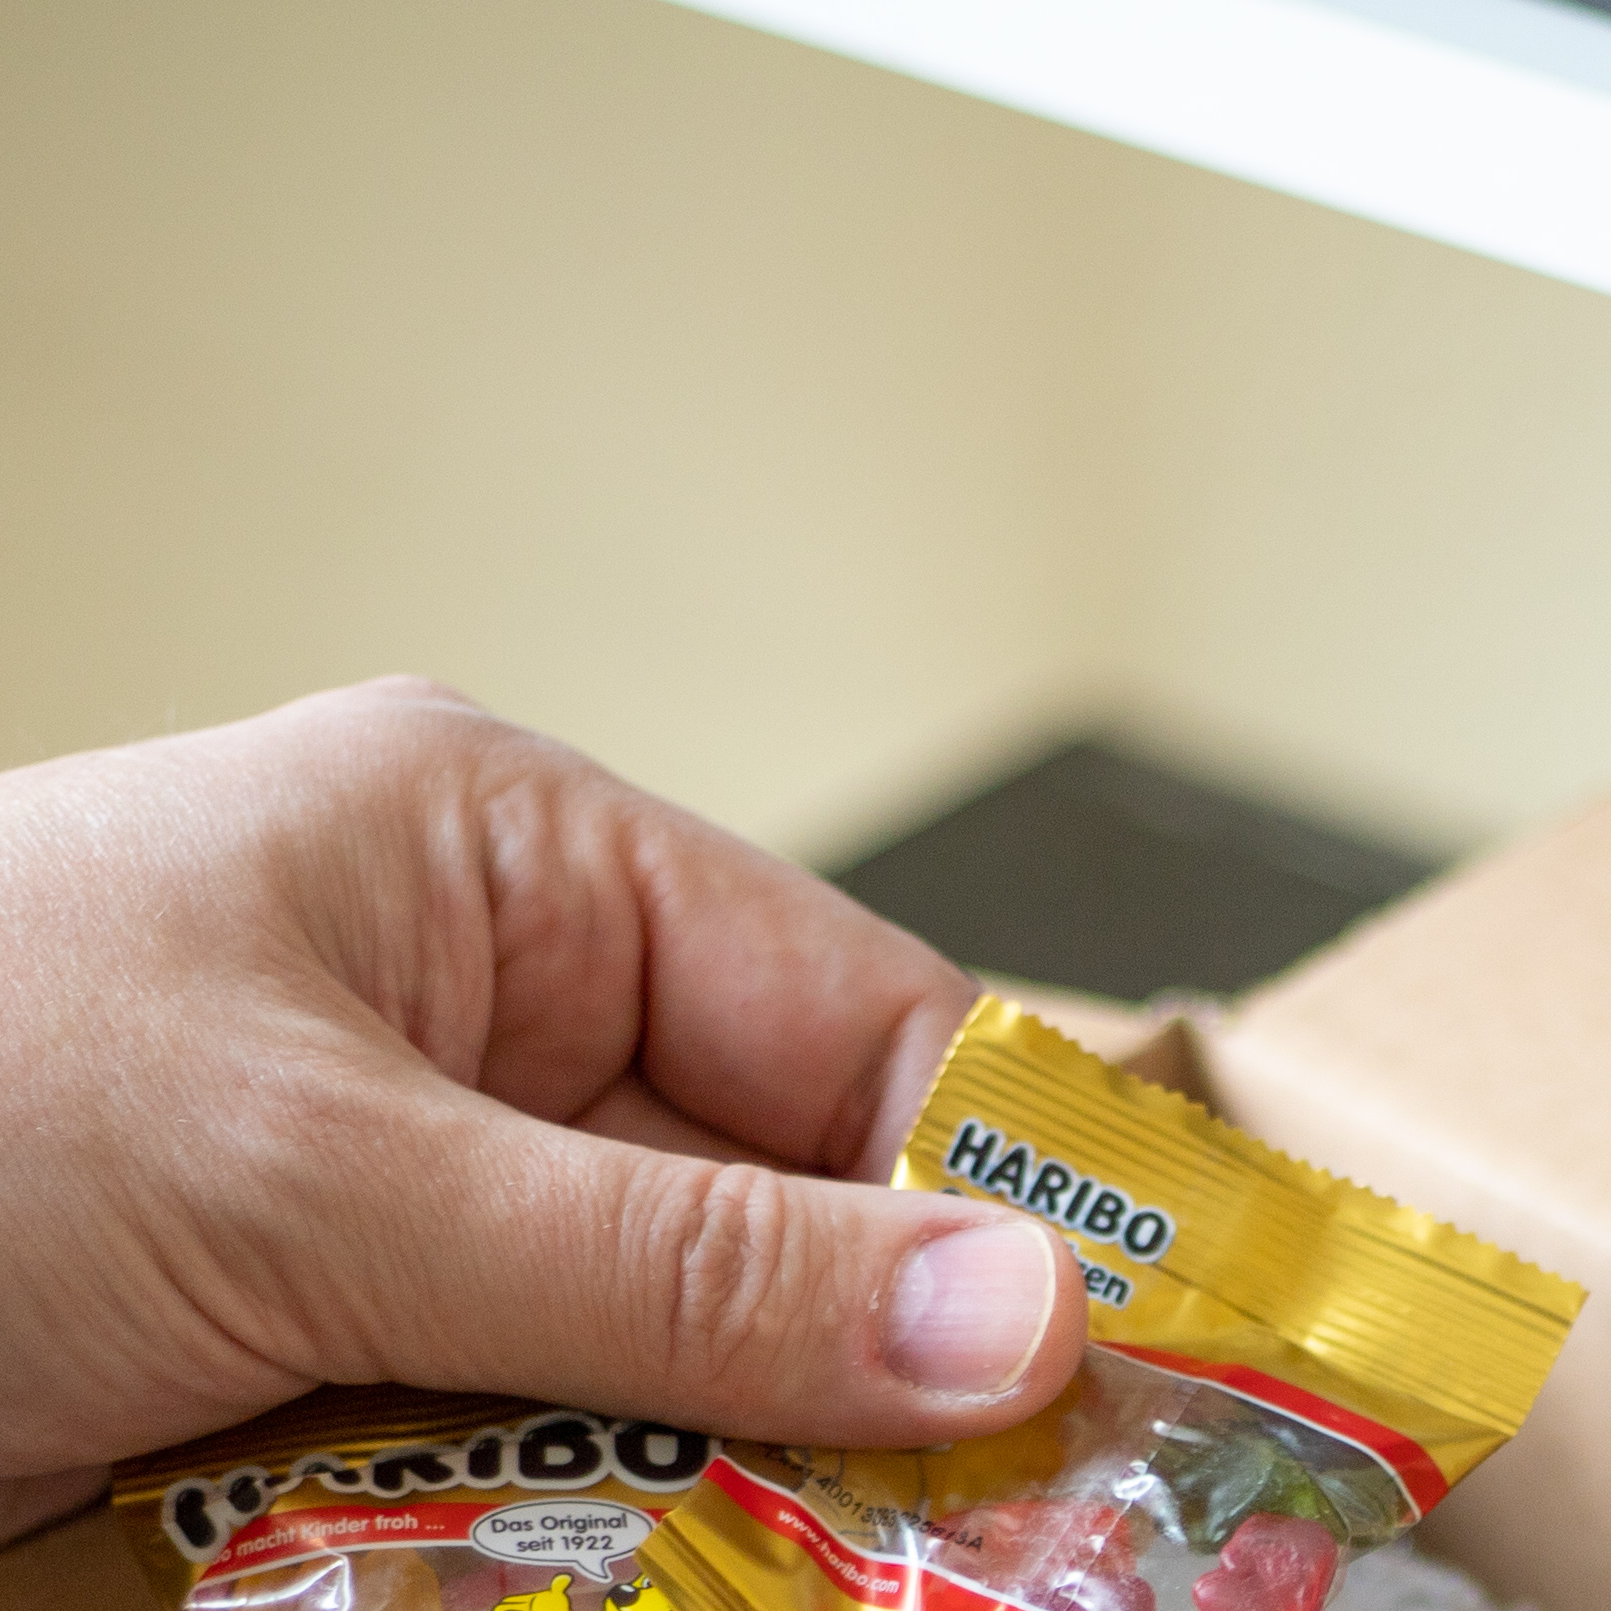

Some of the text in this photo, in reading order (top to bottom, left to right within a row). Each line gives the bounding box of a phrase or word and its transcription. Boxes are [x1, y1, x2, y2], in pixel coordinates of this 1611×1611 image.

[946, 1120, 1169, 1257] HARIBO
[236, 1526, 296, 1556] macht
[299, 1517, 370, 1540] Kinder
[374, 1513, 419, 1531] froh
[491, 1512, 628, 1534] Das Original
[517, 1535, 614, 1552] seit 1922
[777, 1509, 901, 1595] www.haribo.com
